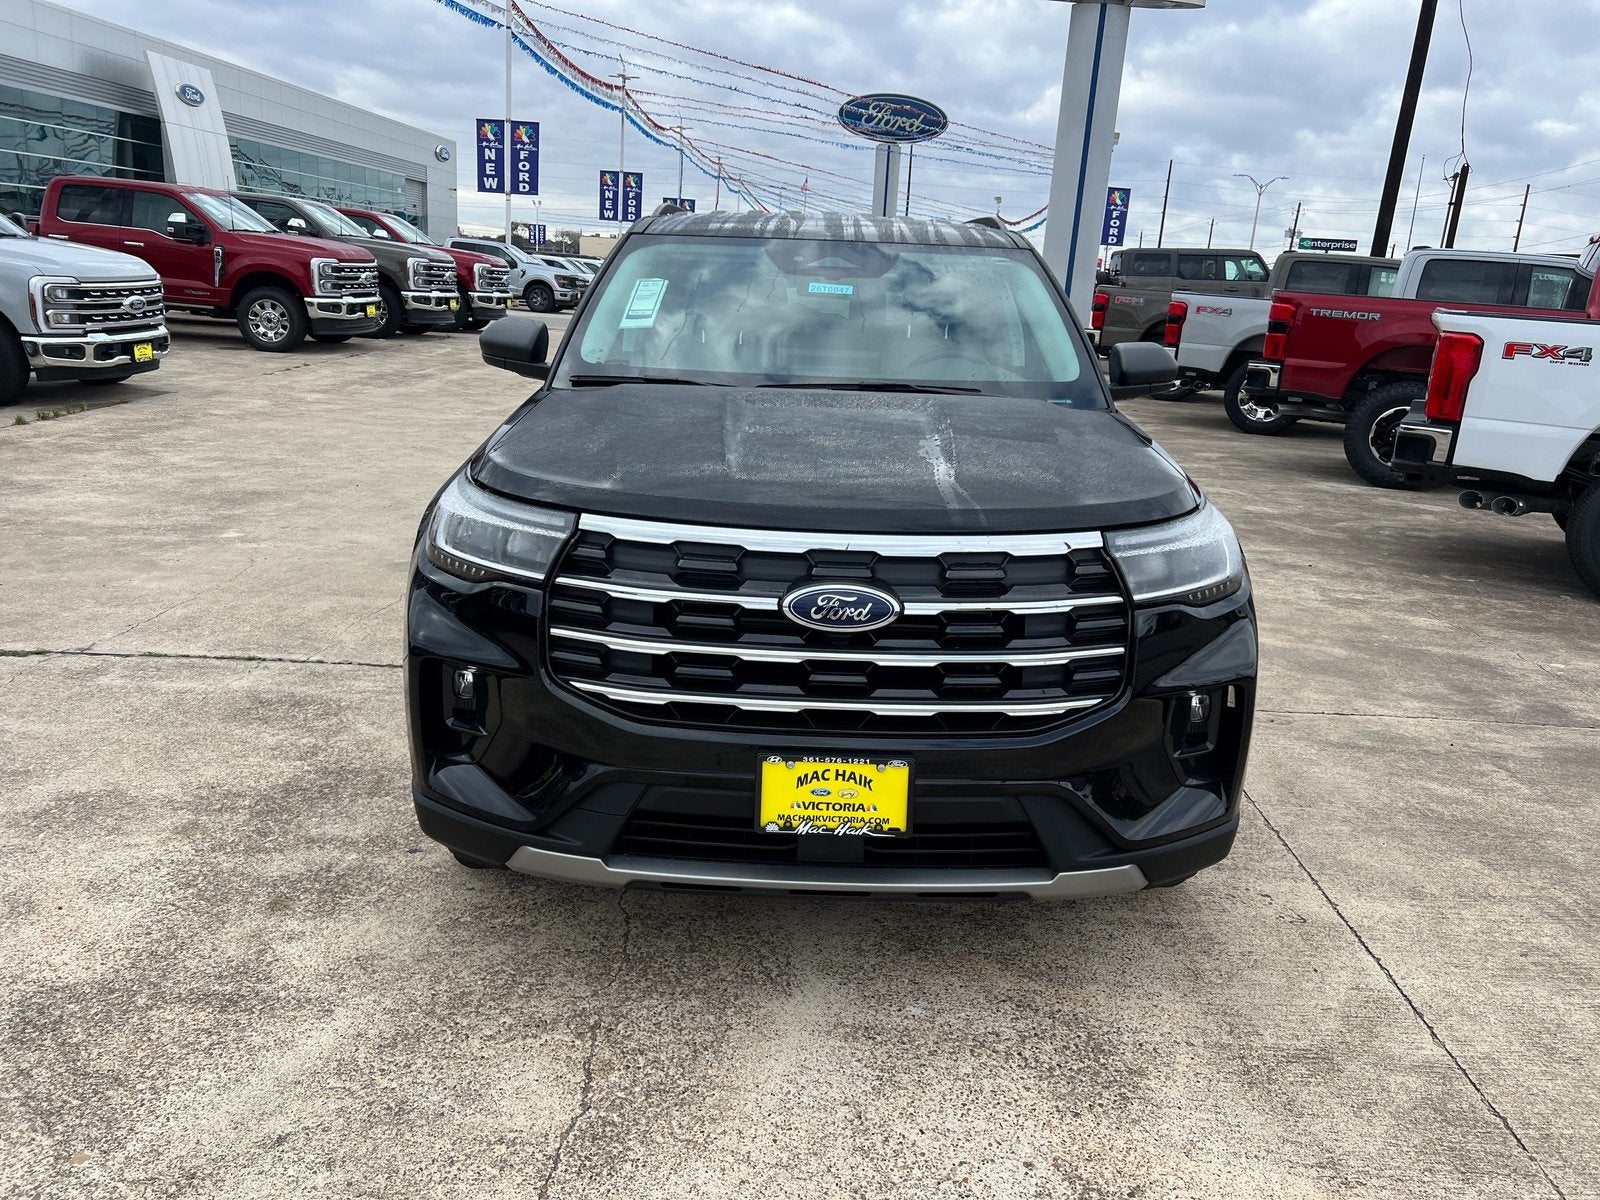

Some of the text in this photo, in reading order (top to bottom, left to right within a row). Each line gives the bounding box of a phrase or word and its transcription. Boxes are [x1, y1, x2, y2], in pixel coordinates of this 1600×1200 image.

[861, 101, 926, 132] Ford
[483, 148, 499, 189] NEW
[518, 150, 530, 192] FORD
[603, 190, 614, 219] NEW
[627, 192, 636, 220] FORD
[1107, 210, 1120, 244] FORD
[1301, 240, 1356, 249] enterprise
[1195, 306, 1232, 316] FX4
[1310, 308, 1380, 321] TREMOR
[1502, 341, 1592, 362] FX4
[810, 594, 872, 621] Ford
[802, 756, 870, 765] 361-576-1221
[796, 768, 873, 792] MAC HAIK
[801, 801, 867, 813] VICTORIA
[794, 820, 876, 836] Mac Haik
